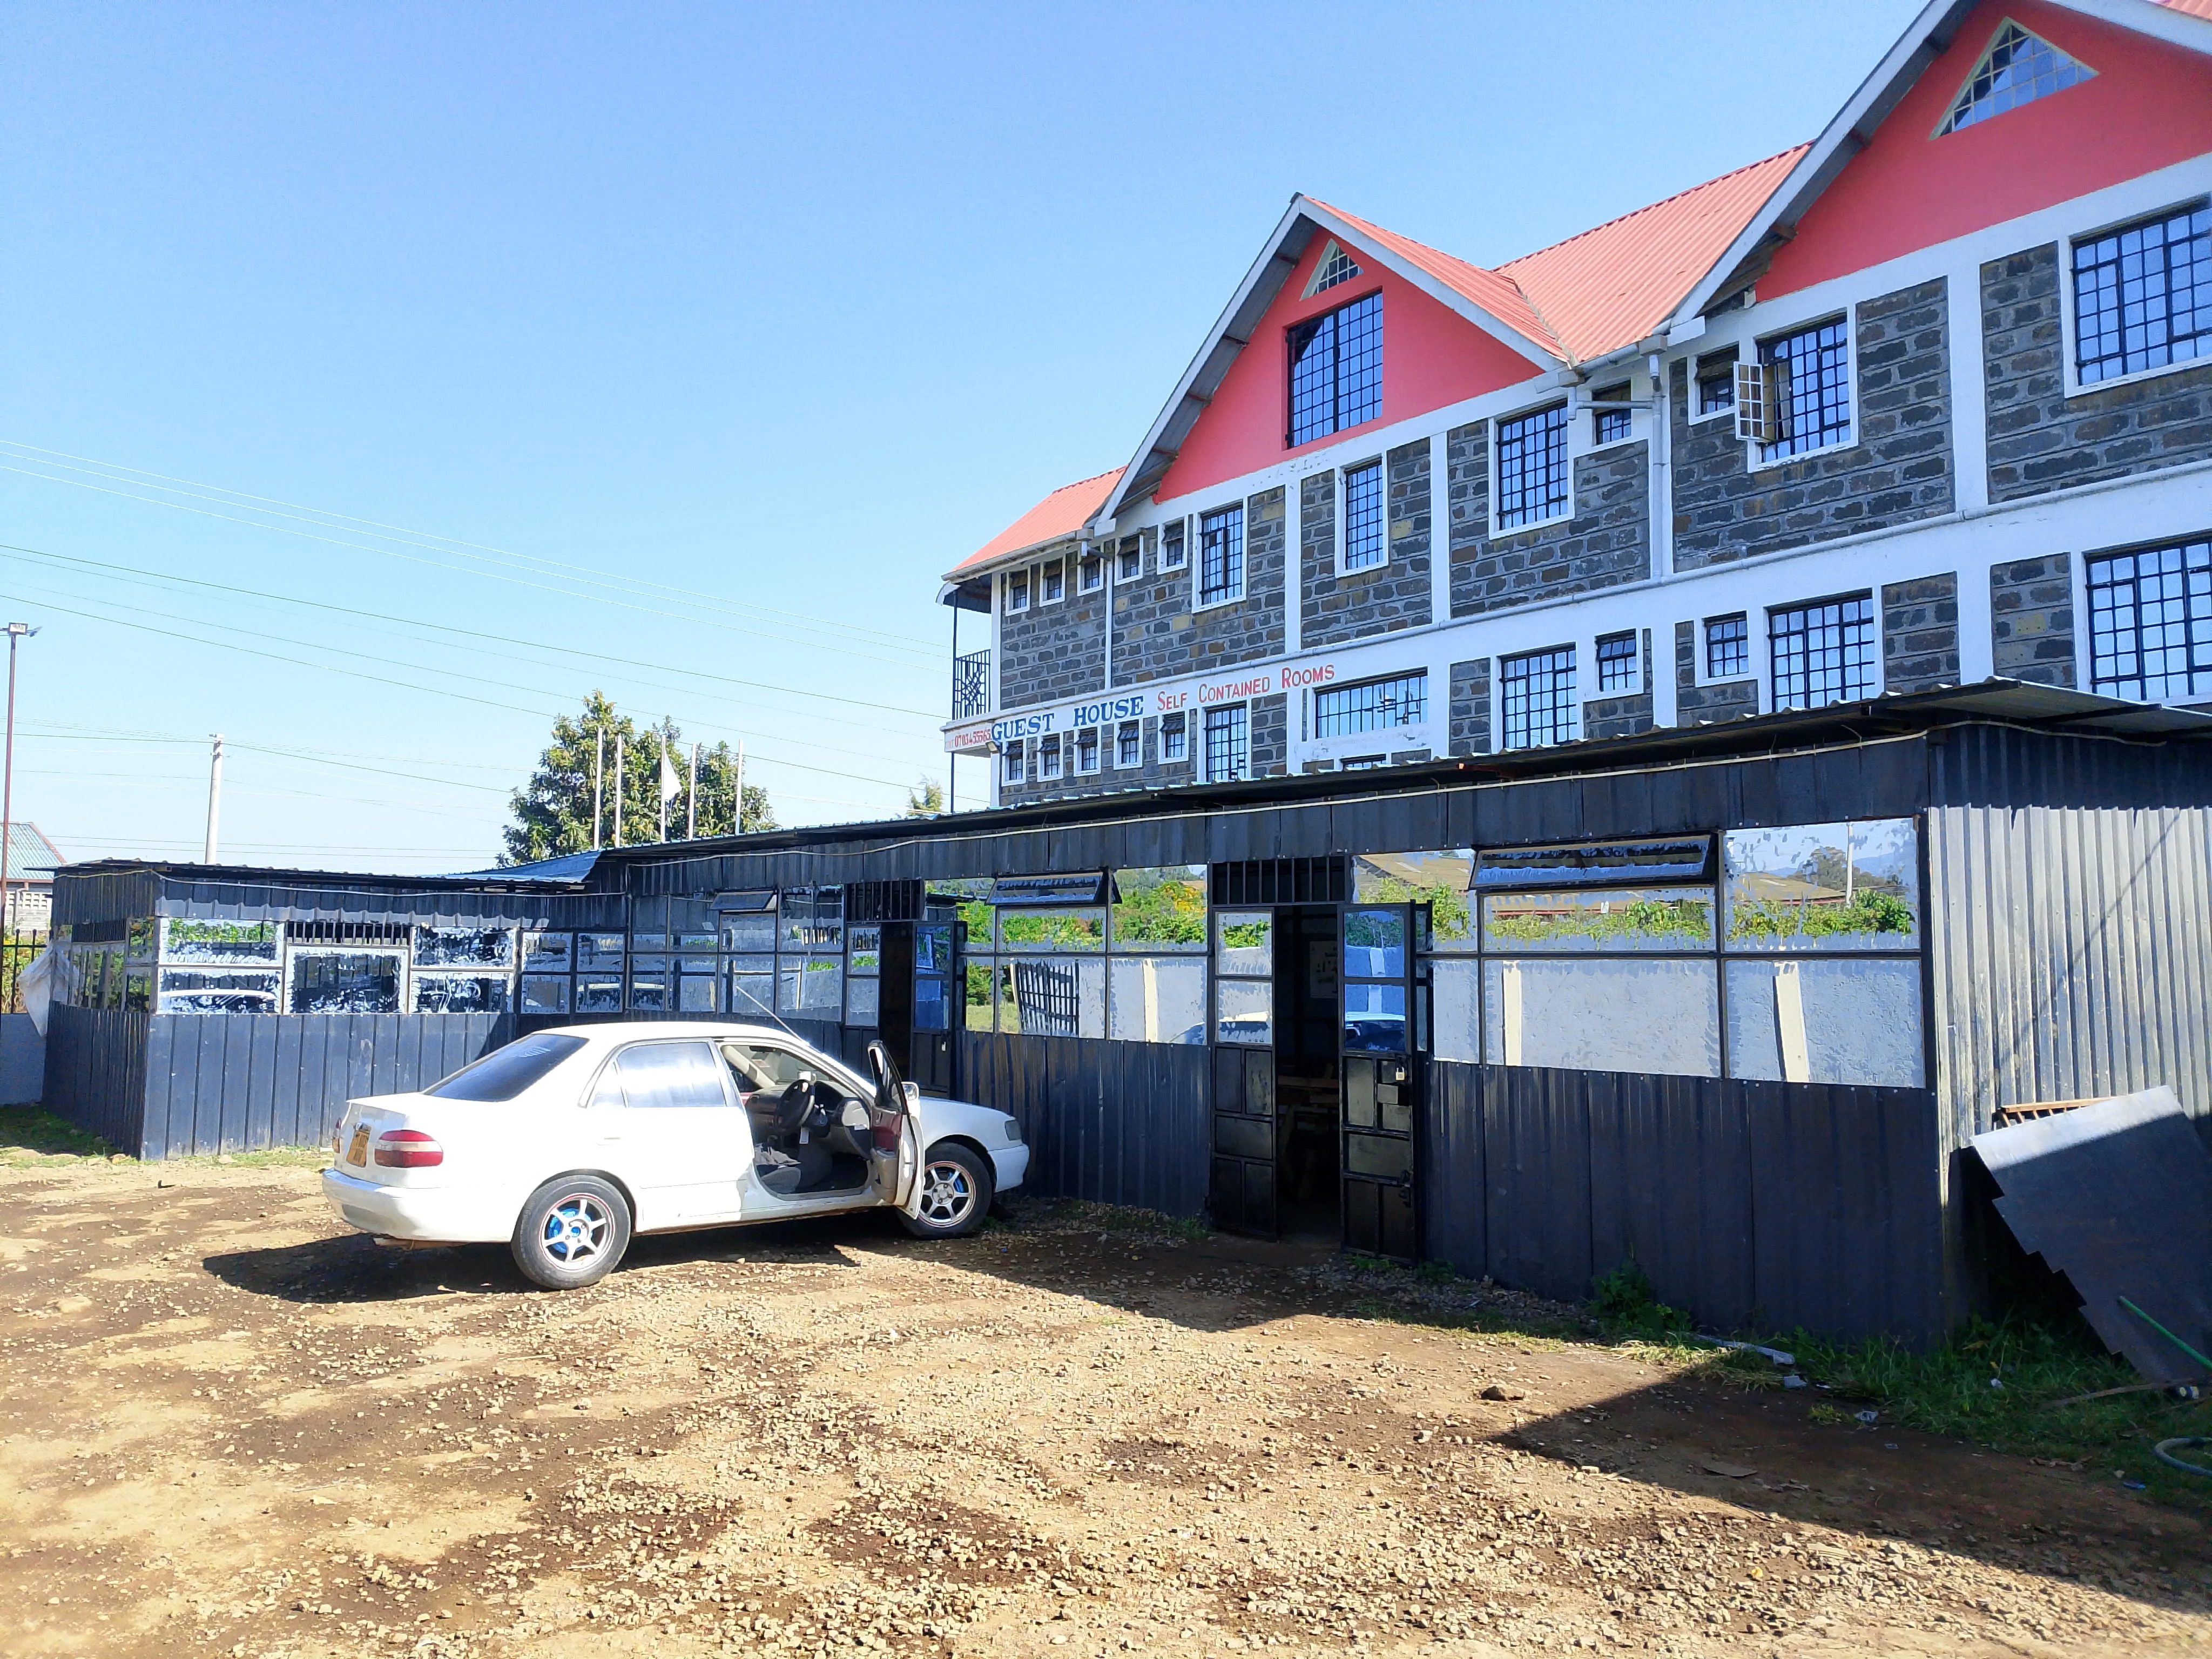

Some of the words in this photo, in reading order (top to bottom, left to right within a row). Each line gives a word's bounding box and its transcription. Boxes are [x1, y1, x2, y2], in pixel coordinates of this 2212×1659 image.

[1157, 691, 1188, 711] SELF
[1198, 676, 1270, 703] CONTAINED
[1281, 664, 1335, 689] ROOMS
[992, 713, 1055, 741] GUEST
[1073, 696, 1144, 727] HOUSE
